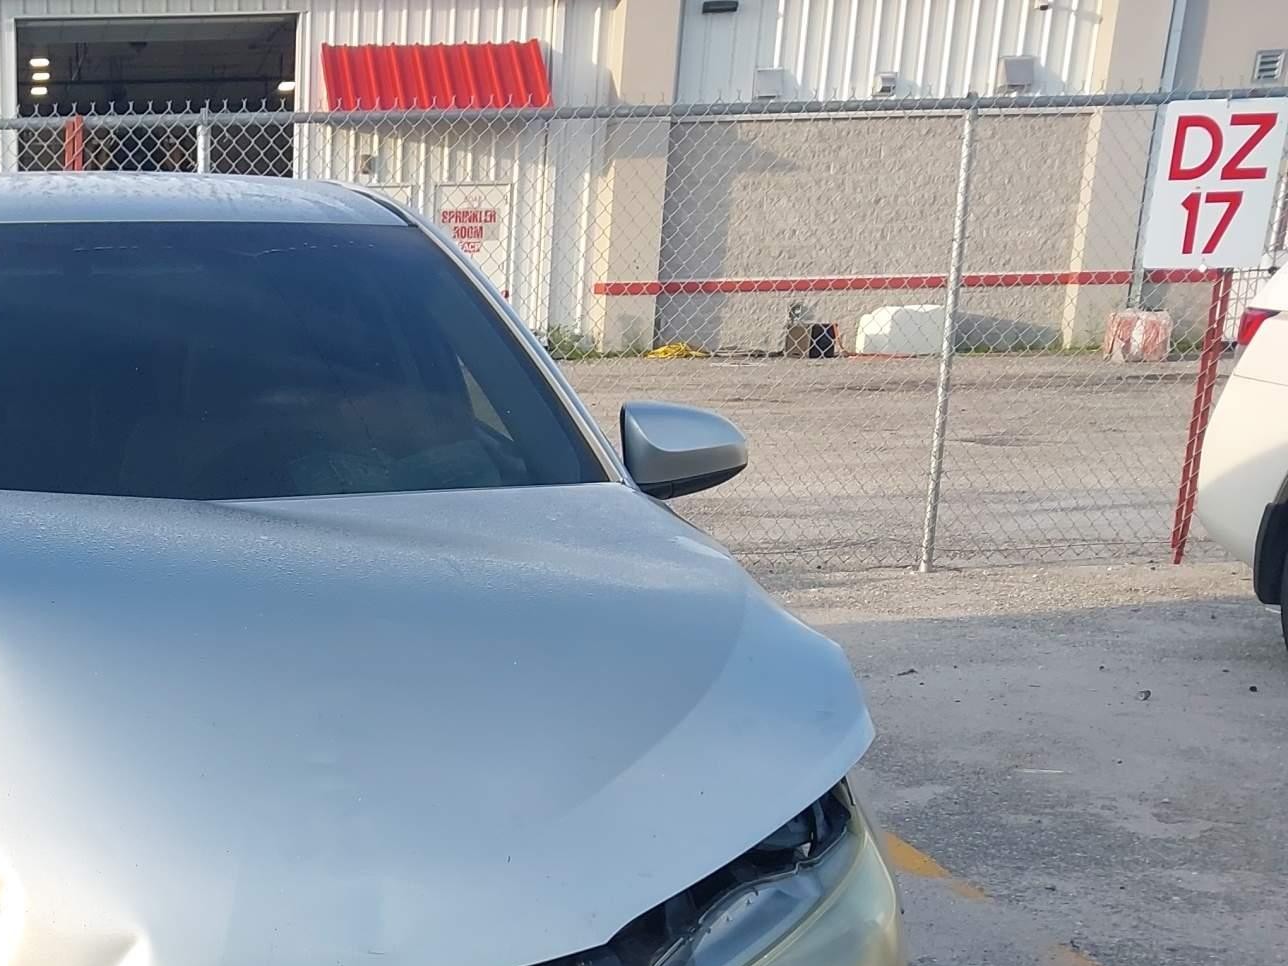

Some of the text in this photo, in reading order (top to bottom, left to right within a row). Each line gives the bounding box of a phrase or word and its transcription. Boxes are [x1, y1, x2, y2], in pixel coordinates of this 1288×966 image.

[1168, 113, 1279, 181] DZ
[441, 210, 496, 223] SPRINKLER
[453, 226, 483, 239] ROOM
[1181, 191, 1244, 254] 17
